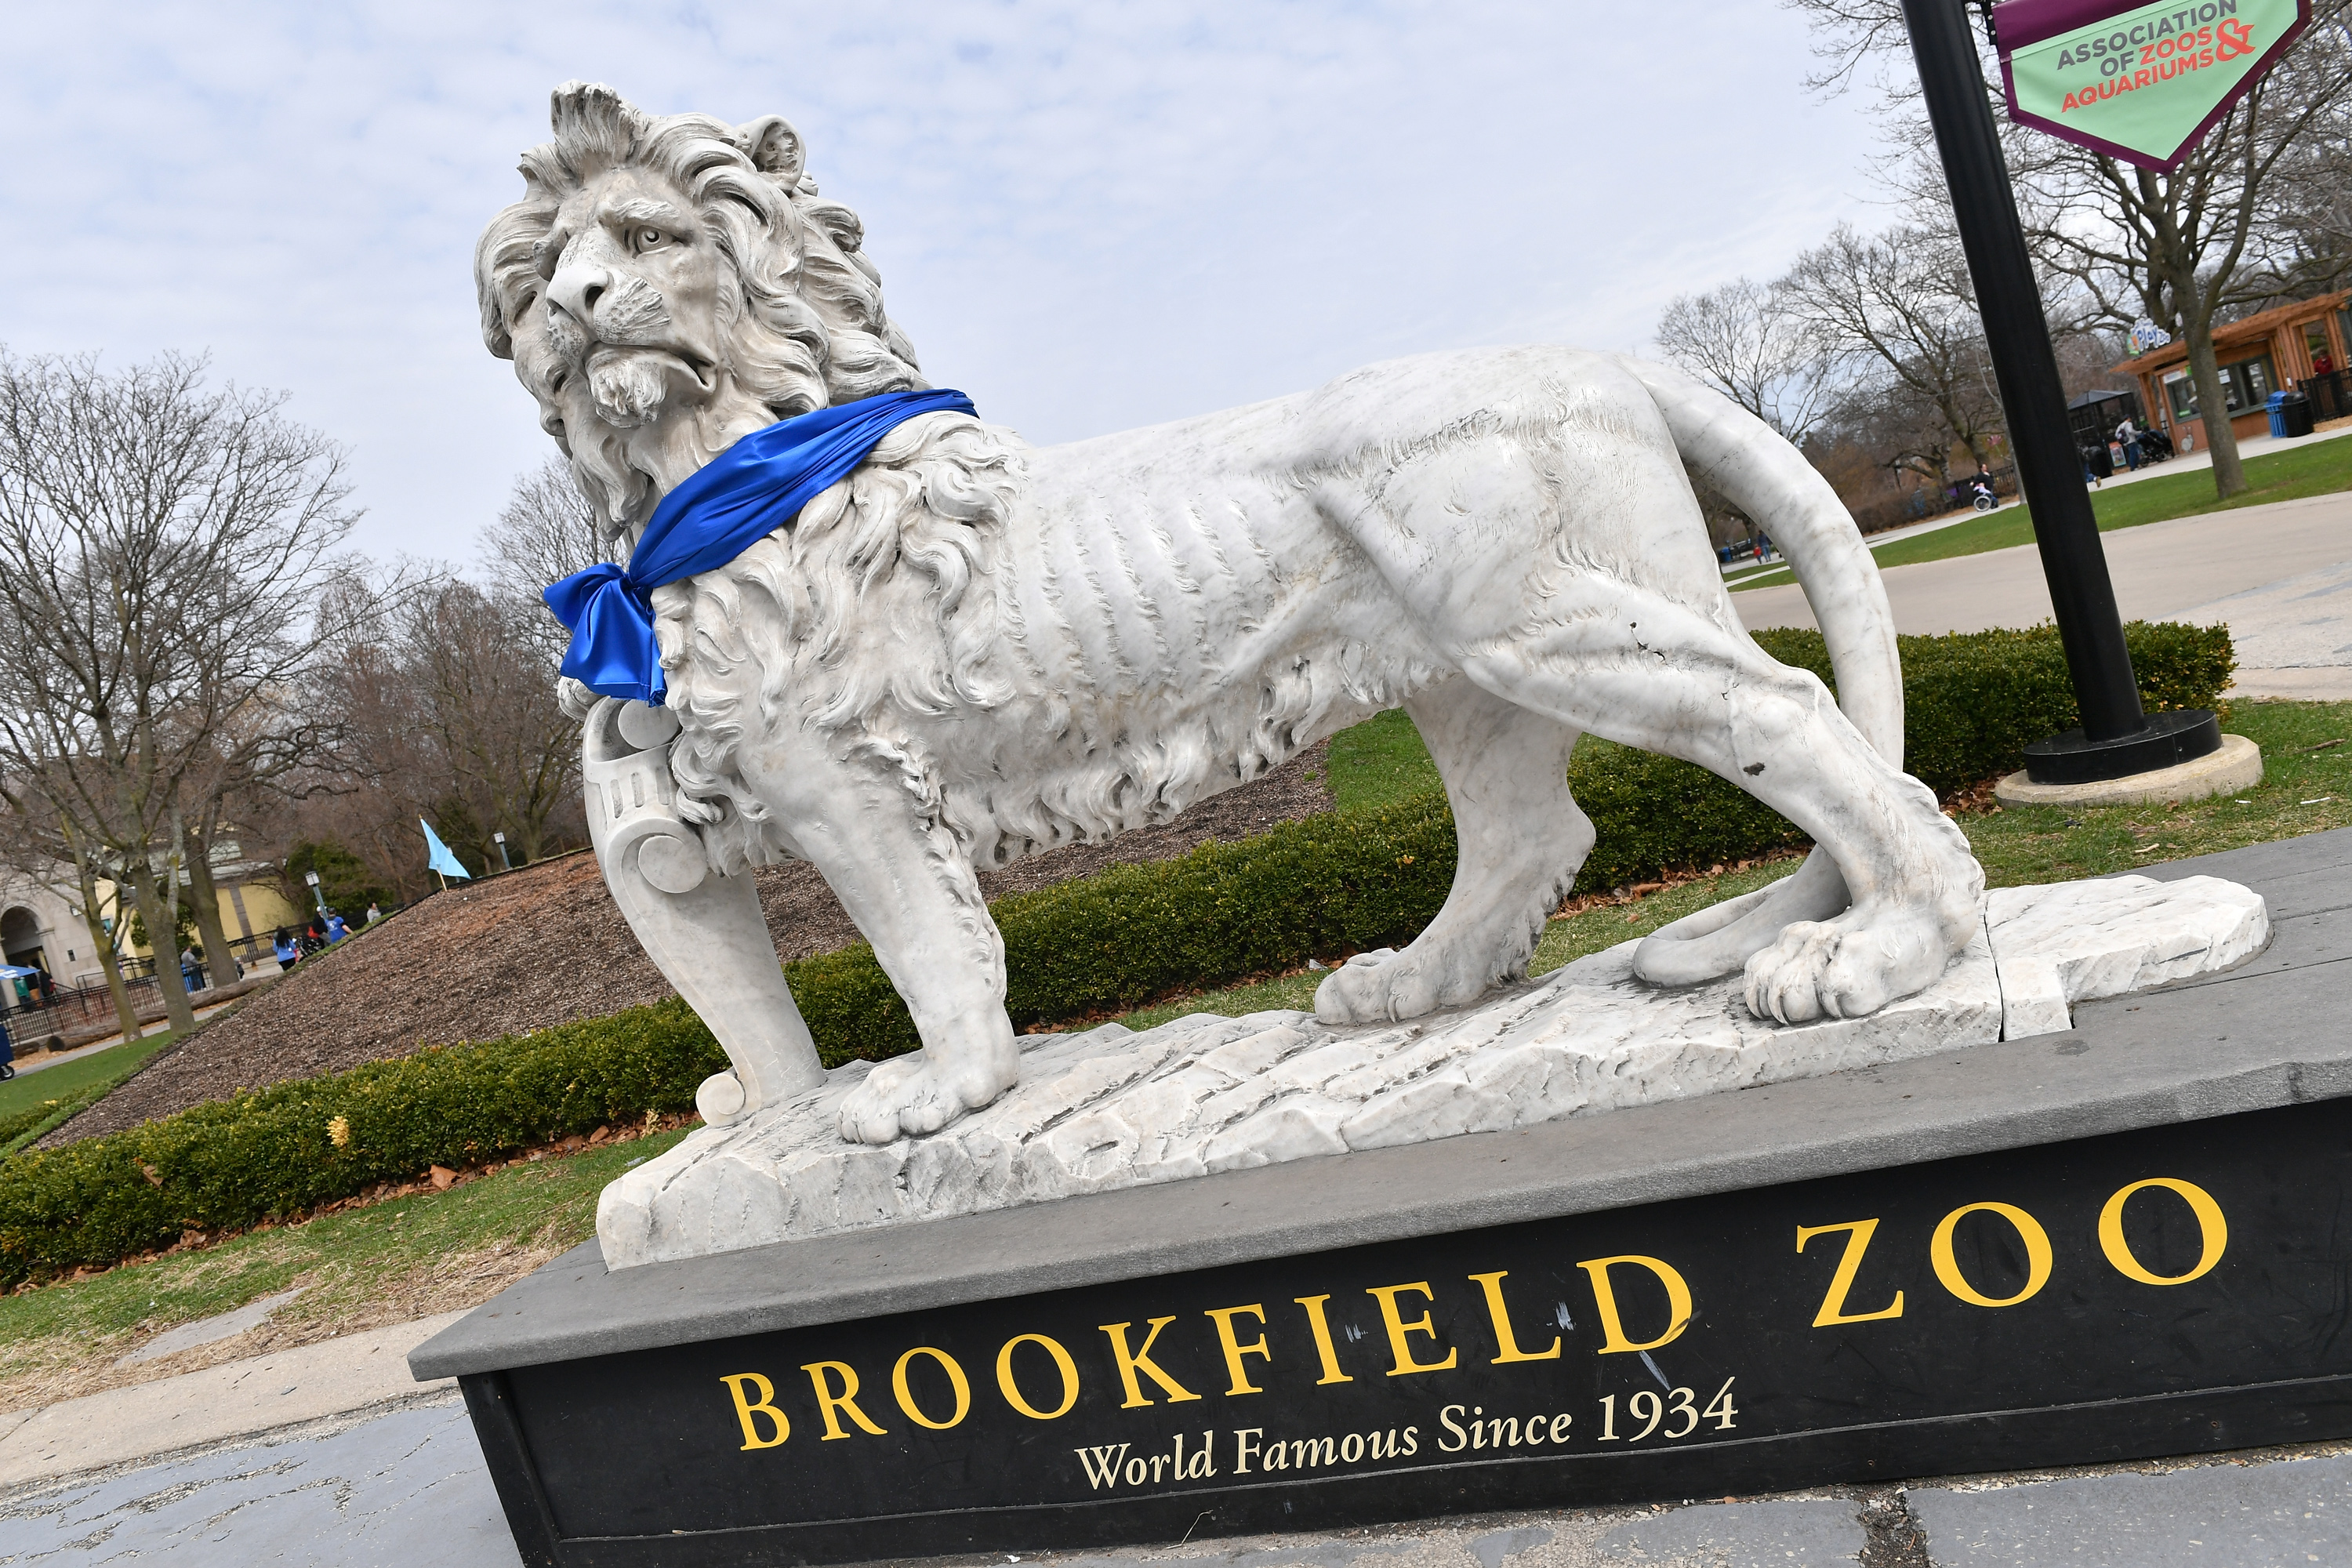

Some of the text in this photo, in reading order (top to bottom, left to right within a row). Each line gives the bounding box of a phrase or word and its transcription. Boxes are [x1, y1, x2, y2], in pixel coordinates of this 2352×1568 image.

[2057, 0, 2238, 71] ASSOCIATION
[2100, 17, 2256, 77] OF ZOOS &
[2061, 48, 2214, 113] AQUARIUMS
[2136, 325, 2158, 350] Play
[719, 1178, 2228, 1451] BROOKFIELD ZOO
[1075, 1376, 1739, 1490] World Famous Since 1934
